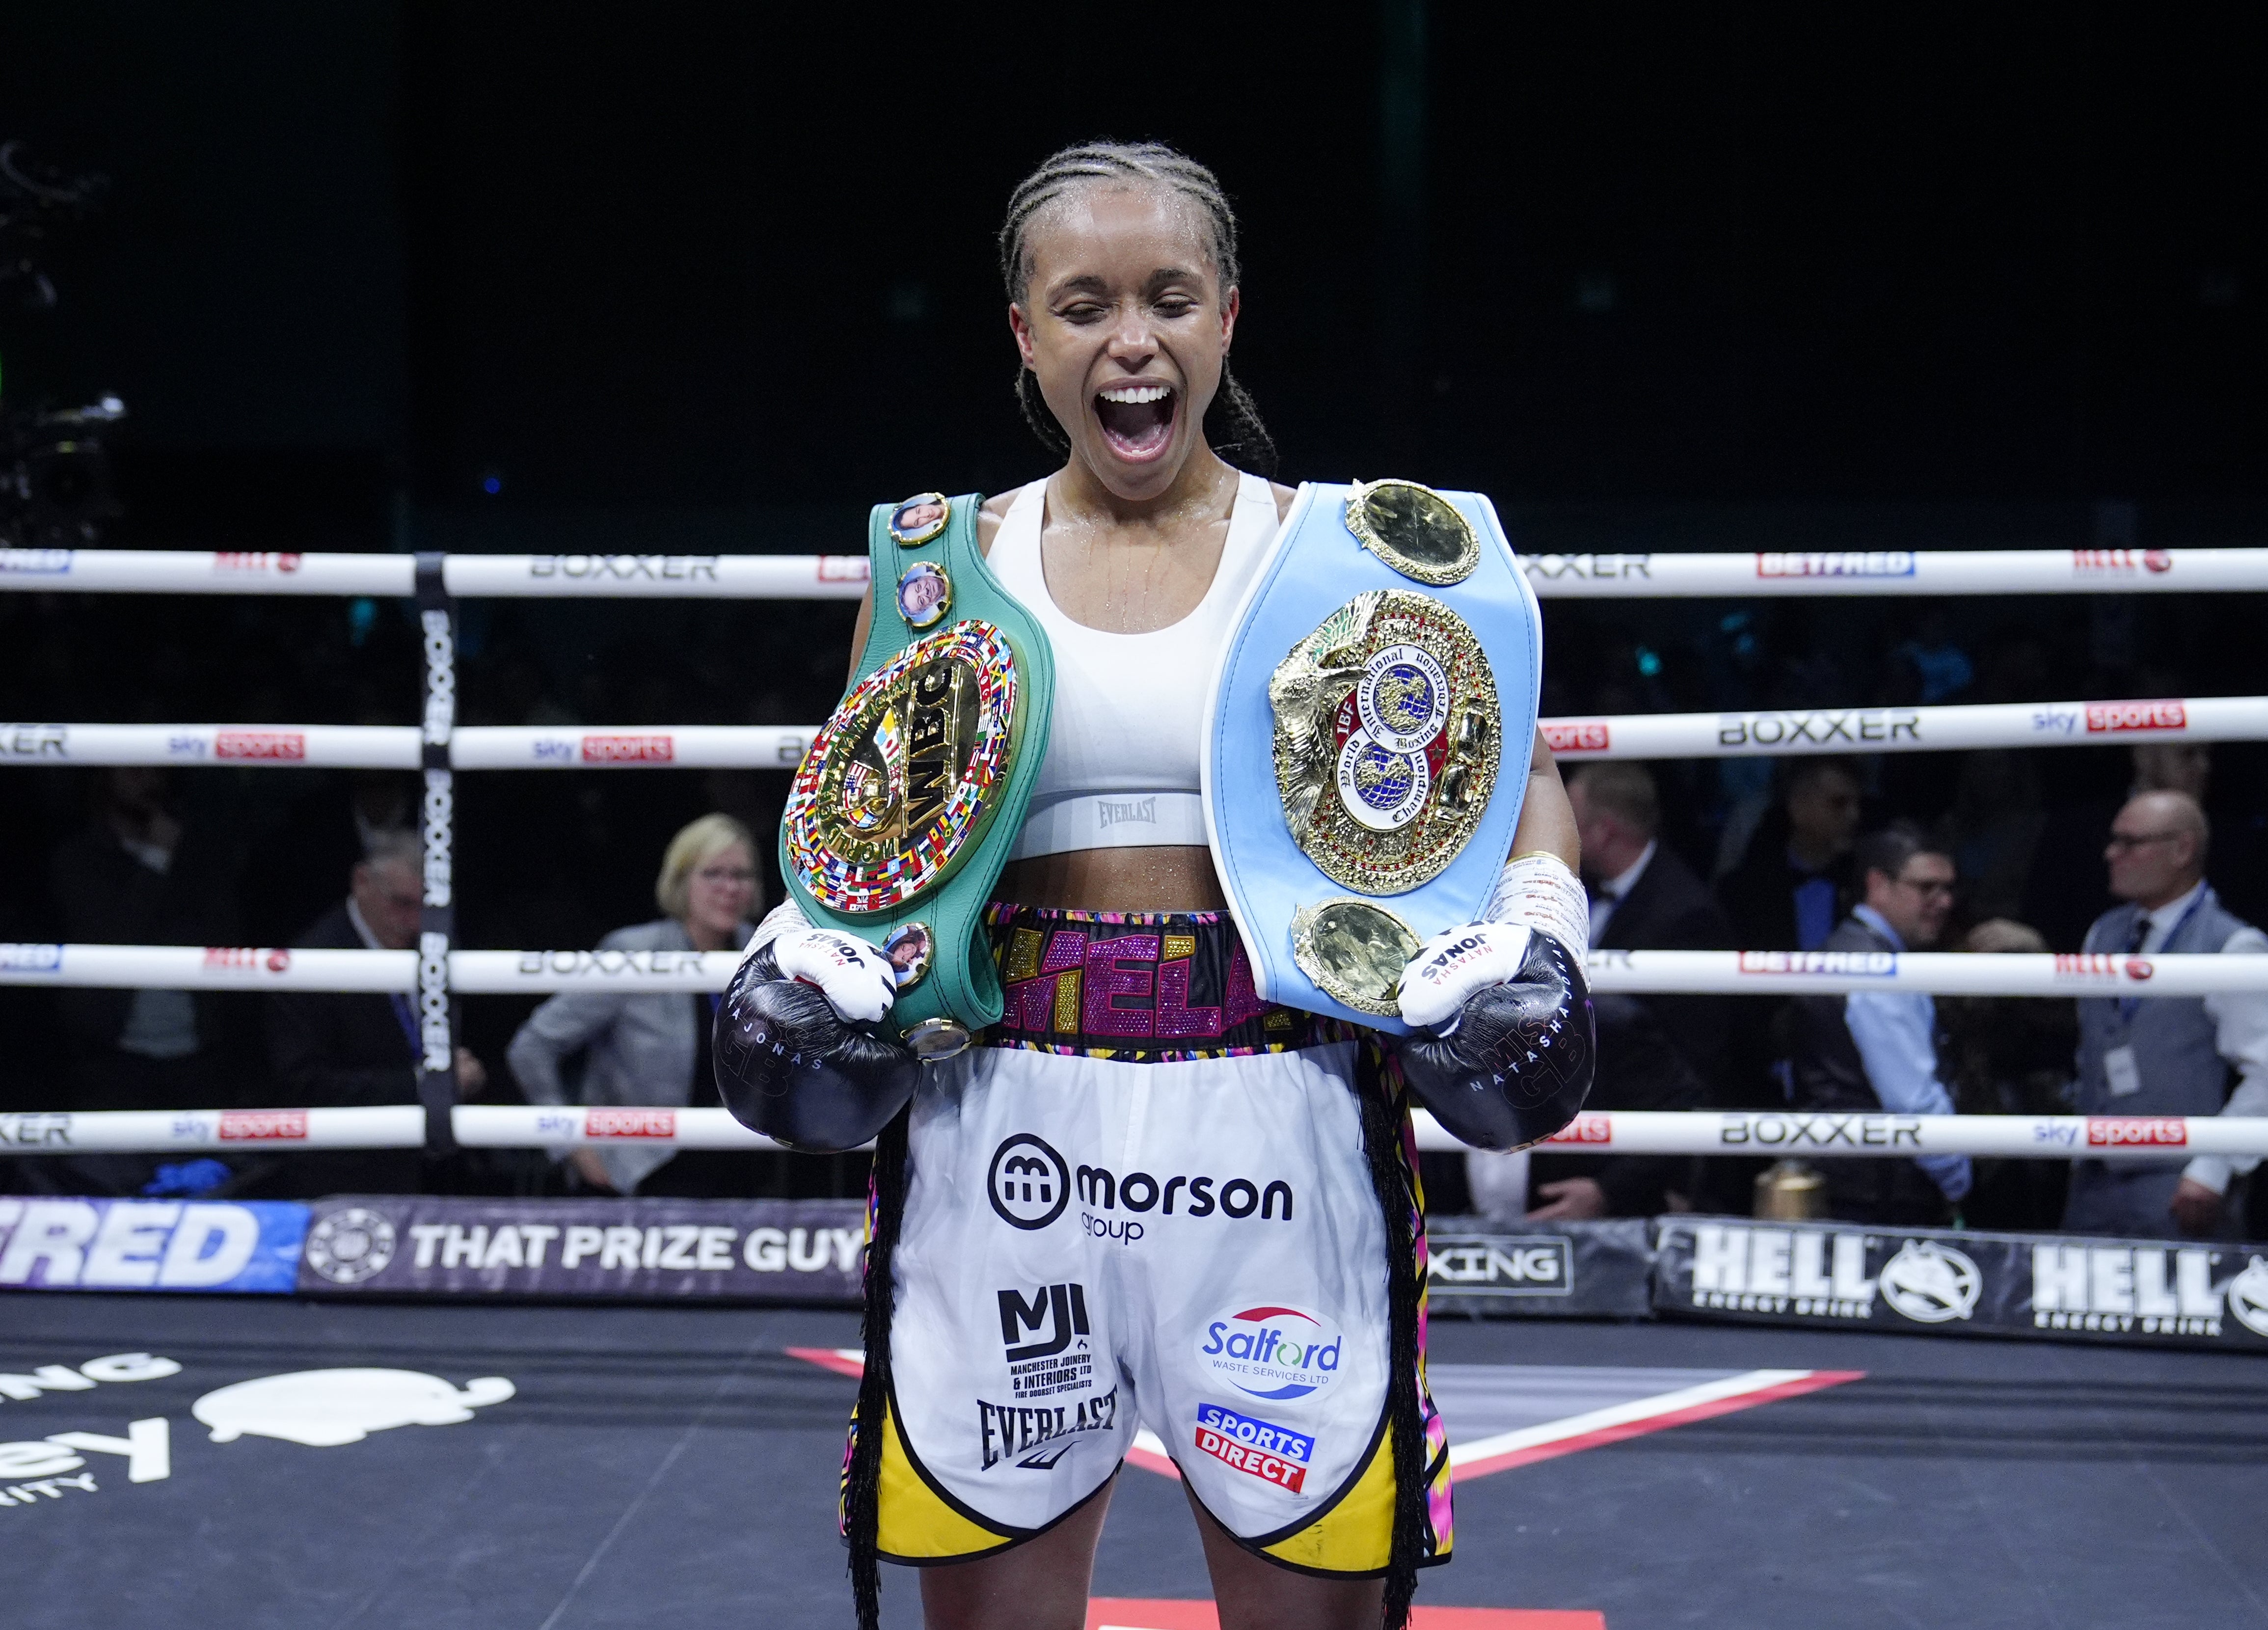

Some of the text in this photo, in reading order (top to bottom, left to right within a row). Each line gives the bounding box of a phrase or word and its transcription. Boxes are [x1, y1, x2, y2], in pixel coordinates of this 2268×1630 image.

[1524, 554, 1651, 579] XXER
[1416, 652, 1446, 724] Federation
[1337, 702, 1354, 735] IBF
[1719, 710, 1920, 747] BOXXER
[2088, 702, 2184, 732] sports
[583, 736, 673, 761] sports
[1394, 722, 1439, 750] Boxing
[1340, 738, 1427, 823] World Champion
[1097, 796, 1157, 829] EVERLAST
[807, 933, 865, 969] JONAS
[1421, 933, 1487, 980] JONAS
[1433, 945, 1493, 985] NATASHA
[1469, 1005, 1569, 1092] NATASHA
[1545, 937, 1573, 1001] JONAS
[743, 1022, 822, 1069] JONAS
[587, 1112, 675, 1137] sports
[1721, 1115, 1921, 1145] BOXXER
[2034, 1118, 2185, 1146] sky sports
[1077, 1164, 1293, 1221] morson
[1081, 1211, 1144, 1246] group
[409, 1223, 865, 1273] THAT PRIZE GUY
[1428, 1248, 1559, 1282] XING
[1693, 1225, 1876, 1303] HELL
[2032, 1243, 2224, 1318] HELL
[2141, 1317, 2222, 1337] DRINK
[1202, 1322, 1342, 1371] Salford
[1010, 1354, 1091, 1376] MANCHESTER JOINERY
[1013, 1365, 1092, 1390] & INTERIORS LTD
[1212, 1359, 1329, 1385] WASTE SERVICES LTD
[1015, 1379, 1092, 1399] FIRE DOORSET SPECIALISTS
[976, 1384, 1118, 1472] EVERLAST
[1204, 1409, 1307, 1460] SPORTS
[1201, 1432, 1298, 1485] DIRECT
